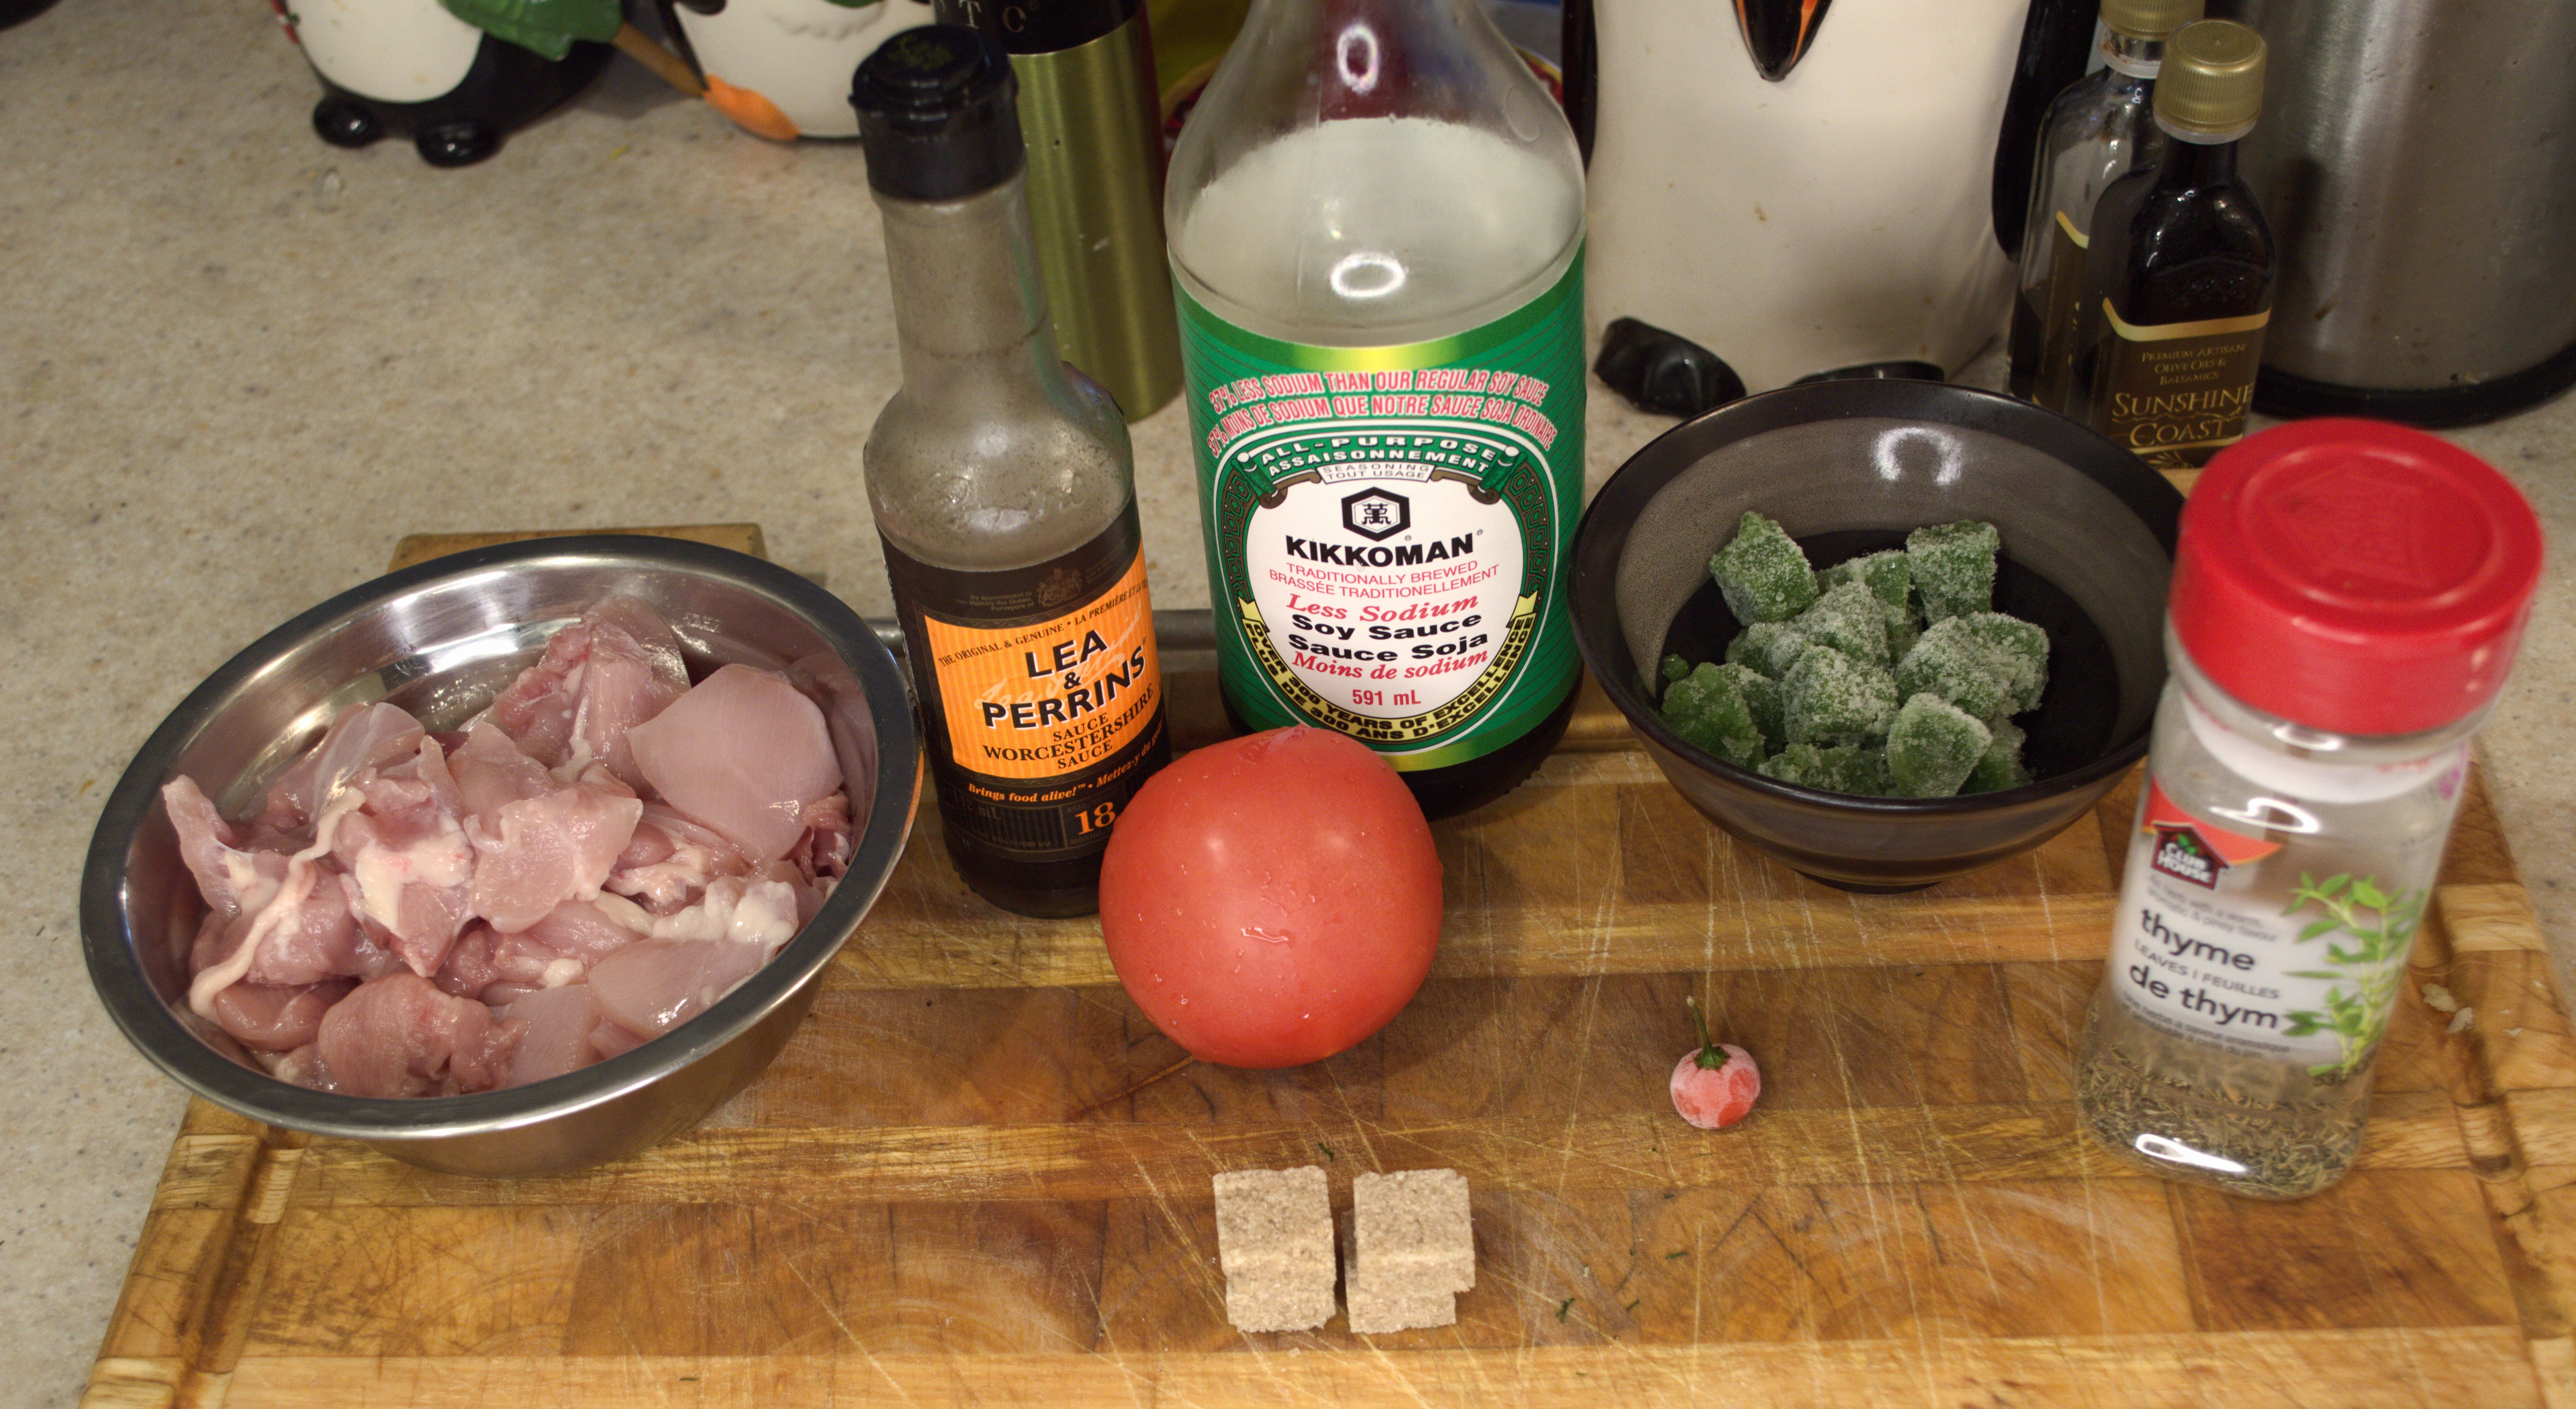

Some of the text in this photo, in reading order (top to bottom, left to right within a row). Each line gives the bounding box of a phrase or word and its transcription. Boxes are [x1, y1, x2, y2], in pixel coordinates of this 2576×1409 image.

[2142, 344, 2245, 362] PREMIUM ARTISAN
[2218, 358, 2226, 366] &
[1209, 370, 1549, 414] 37% LESS SODIUM THAN OUR REGULAR SOY SAUCE
[2113, 383, 2254, 417] SUNSHINE
[1207, 394, 1557, 458] 37% MOINS DE SODIUM QUE NOTRE SAUCE SOJA ORDINAIRE
[2130, 420, 2223, 446] COAST
[1261, 436, 1496, 464] ALL-PURPOSE
[1269, 449, 1490, 477] ASSAISONNEMENT
[1323, 463, 1429, 473] SEASONING
[1326, 470, 1426, 479] TOUT USAGE
[1286, 532, 1474, 567] KIKKOMAN
[1270, 564, 1499, 598] BRASSÉE TRADITIONELLEMENT
[1286, 560, 1478, 584] TRADITIONALLY BREWED
[1286, 593, 1478, 622] Less Sodium
[938, 654, 956, 666] THE
[955, 643, 1002, 660] ORIGINAL
[1015, 623, 1064, 645] GENUINE
[1075, 614, 1086, 625] LA
[1089, 591, 1127, 619] PREMIÈRE
[1128, 586, 1136, 598] ET
[1292, 614, 1482, 640] Soy Sauce
[1025, 629, 1109, 679] LEA
[1288, 633, 1488, 661] Sauce Soja
[1245, 616, 1534, 740] PLUS DE 300 ANS D'EXCELLENCE
[1253, 618, 1525, 729] OVER 300 YEARS OF EXCELLENCE
[1292, 650, 1487, 680] Moins de sodium
[982, 645, 1145, 729] PERRINS
[1063, 672, 1082, 690] &
[1352, 689, 1421, 706] 591 mL
[982, 683, 1153, 761] WORCESTERSHIRE
[1053, 712, 1108, 742] SAUCE
[1058, 741, 1112, 769] SAUCE
[969, 783, 1005, 801] Brings
[1009, 793, 1038, 802] food
[1075, 802, 1116, 834] 18
[2157, 849, 2212, 883] HOUSE
[2165, 842, 2207, 871] CLUB
[2141, 908, 2255, 971] thyme
[2135, 939, 2188, 976] LEAVES
[2202, 973, 2280, 999] FEUILLES
[2129, 964, 2278, 1029] de thym
